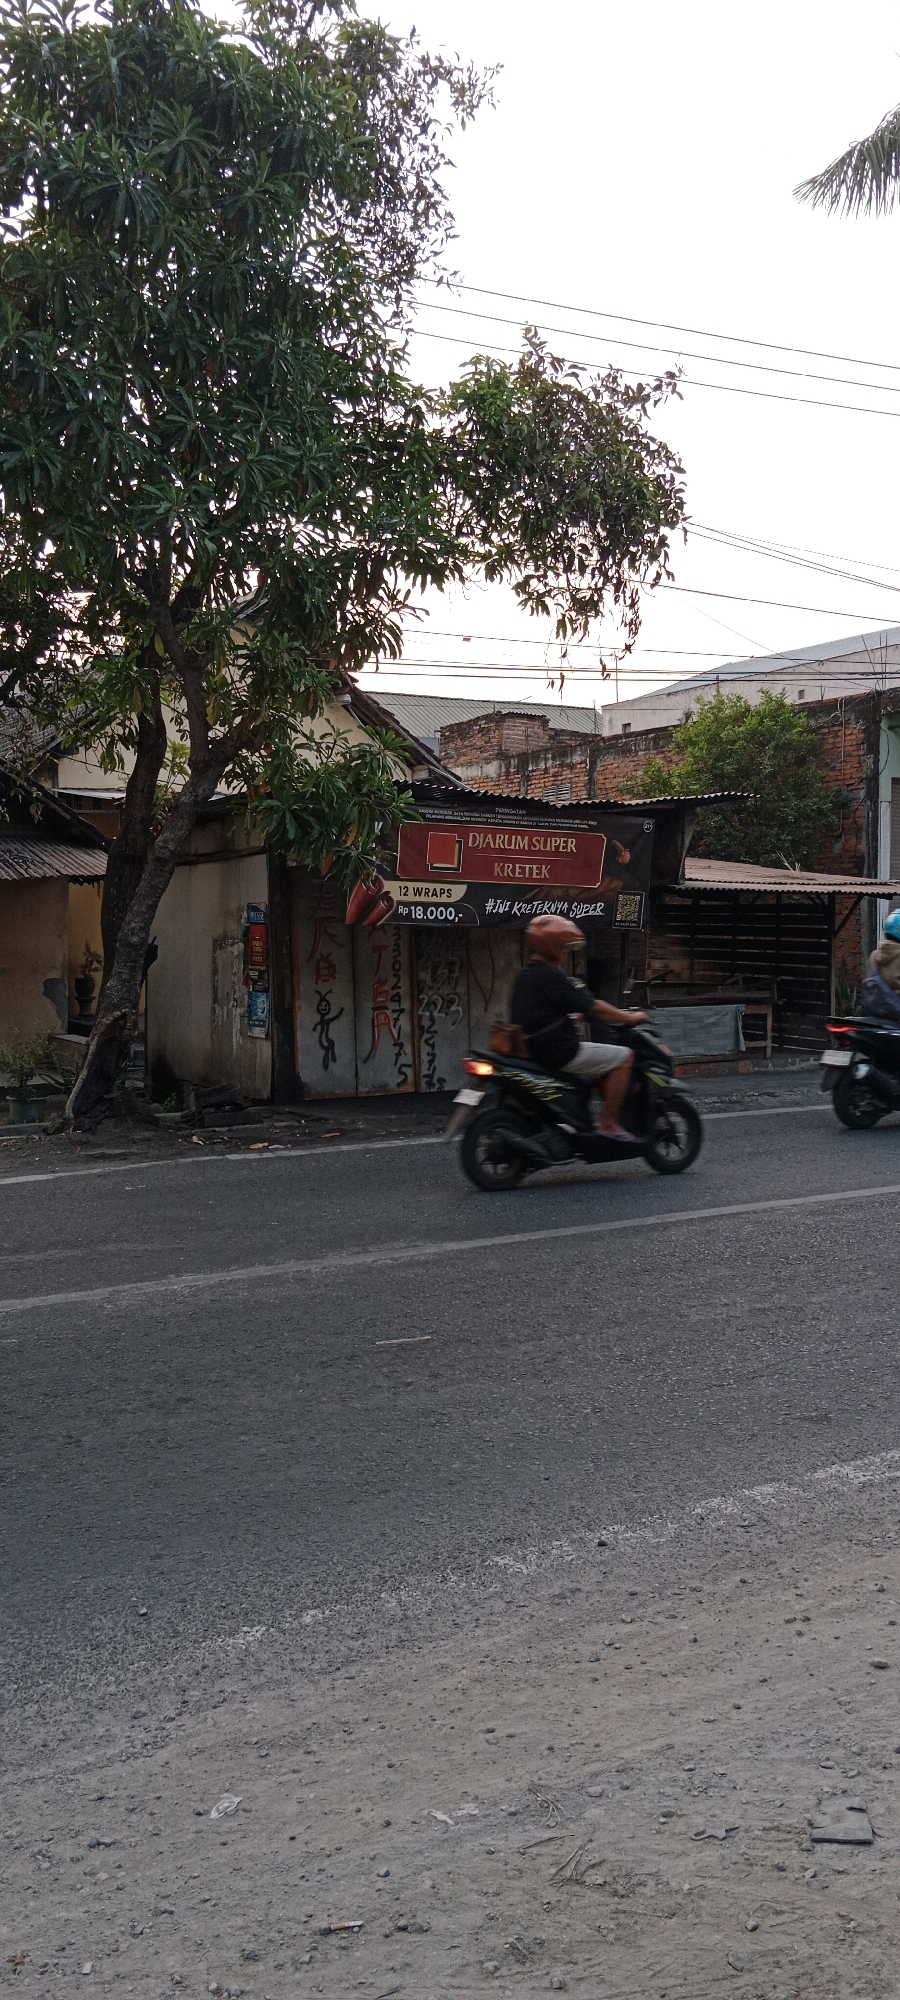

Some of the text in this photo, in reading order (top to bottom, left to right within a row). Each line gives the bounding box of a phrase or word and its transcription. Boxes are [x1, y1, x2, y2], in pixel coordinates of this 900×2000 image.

[467, 831, 577, 854] DJARUM SUPER
[493, 862, 551, 880] KRETEK
[398, 885, 453, 899] 12 WRAPS
[398, 904, 463, 923] Rp 18.000,-
[569, 901, 605, 919] SUPER
